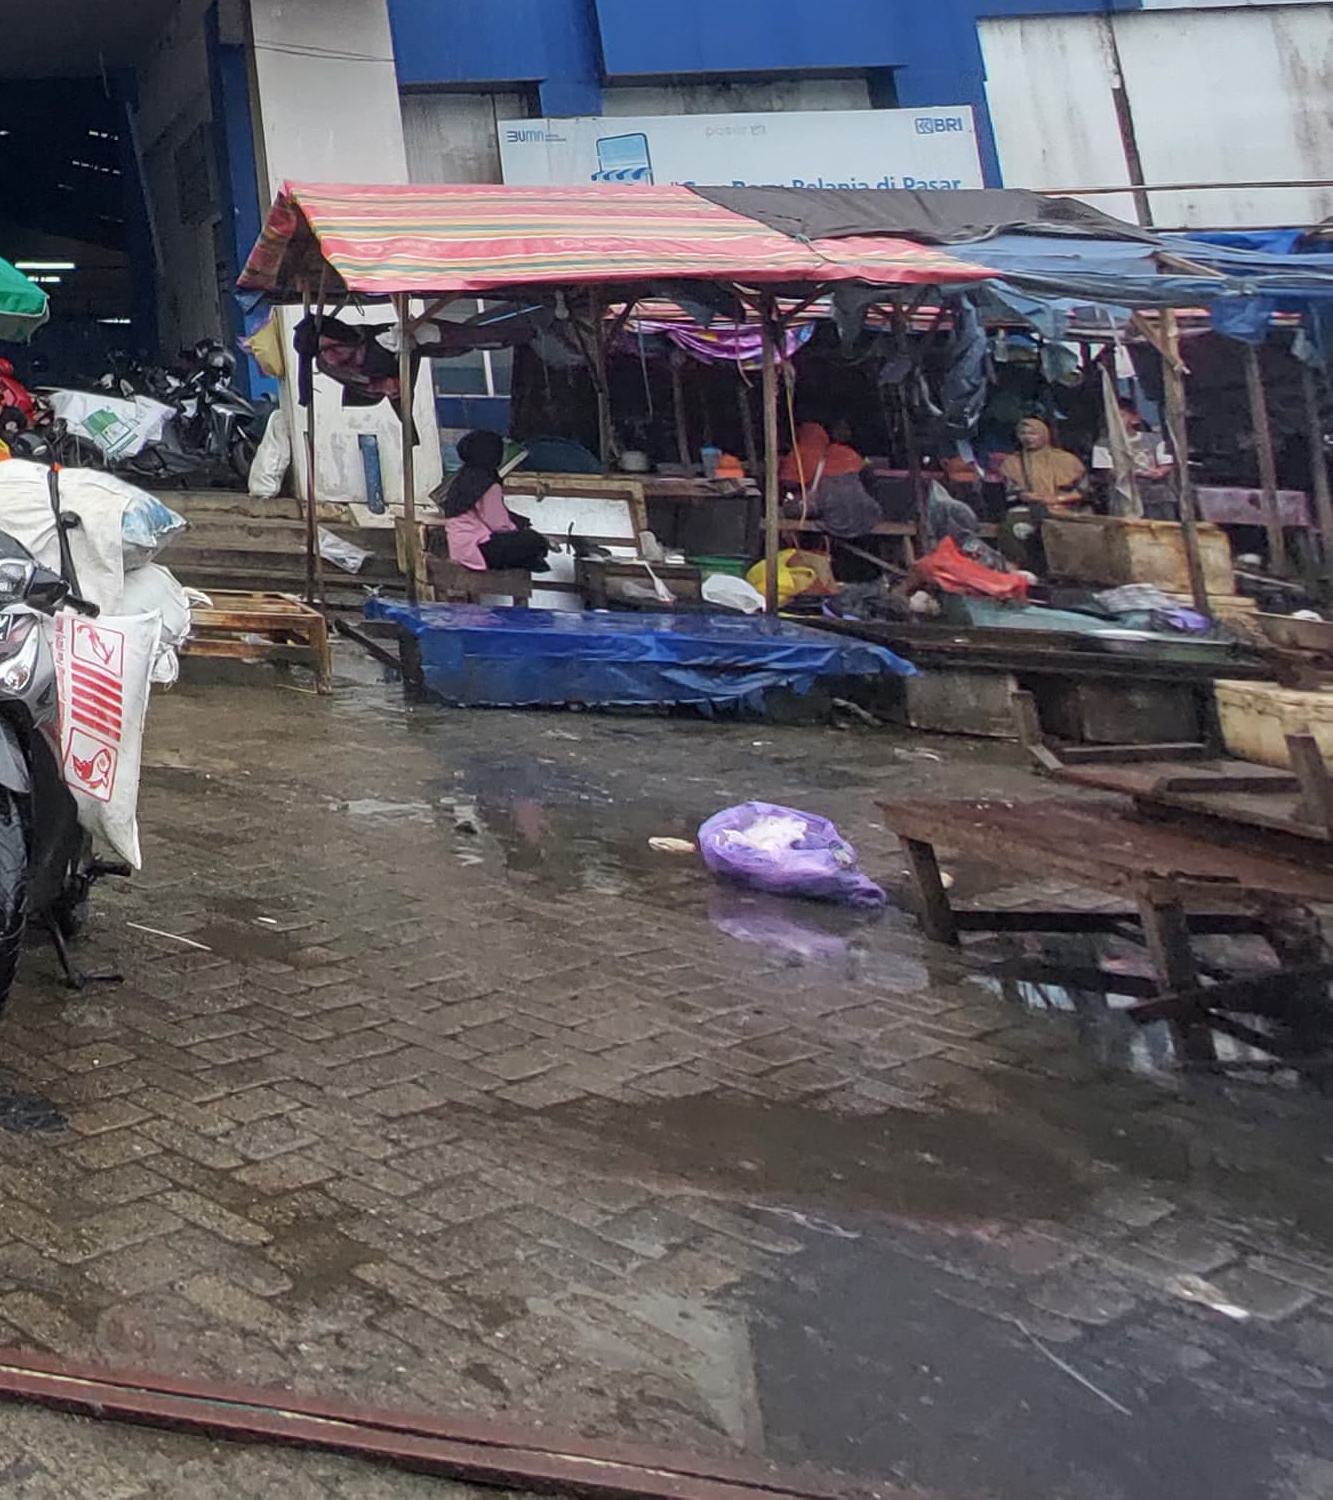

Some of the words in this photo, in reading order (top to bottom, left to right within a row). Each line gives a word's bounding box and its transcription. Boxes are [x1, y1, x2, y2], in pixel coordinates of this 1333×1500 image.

[935, 117, 963, 132] BRI
[876, 176, 895, 190] di
[902, 176, 962, 191] Pasar
